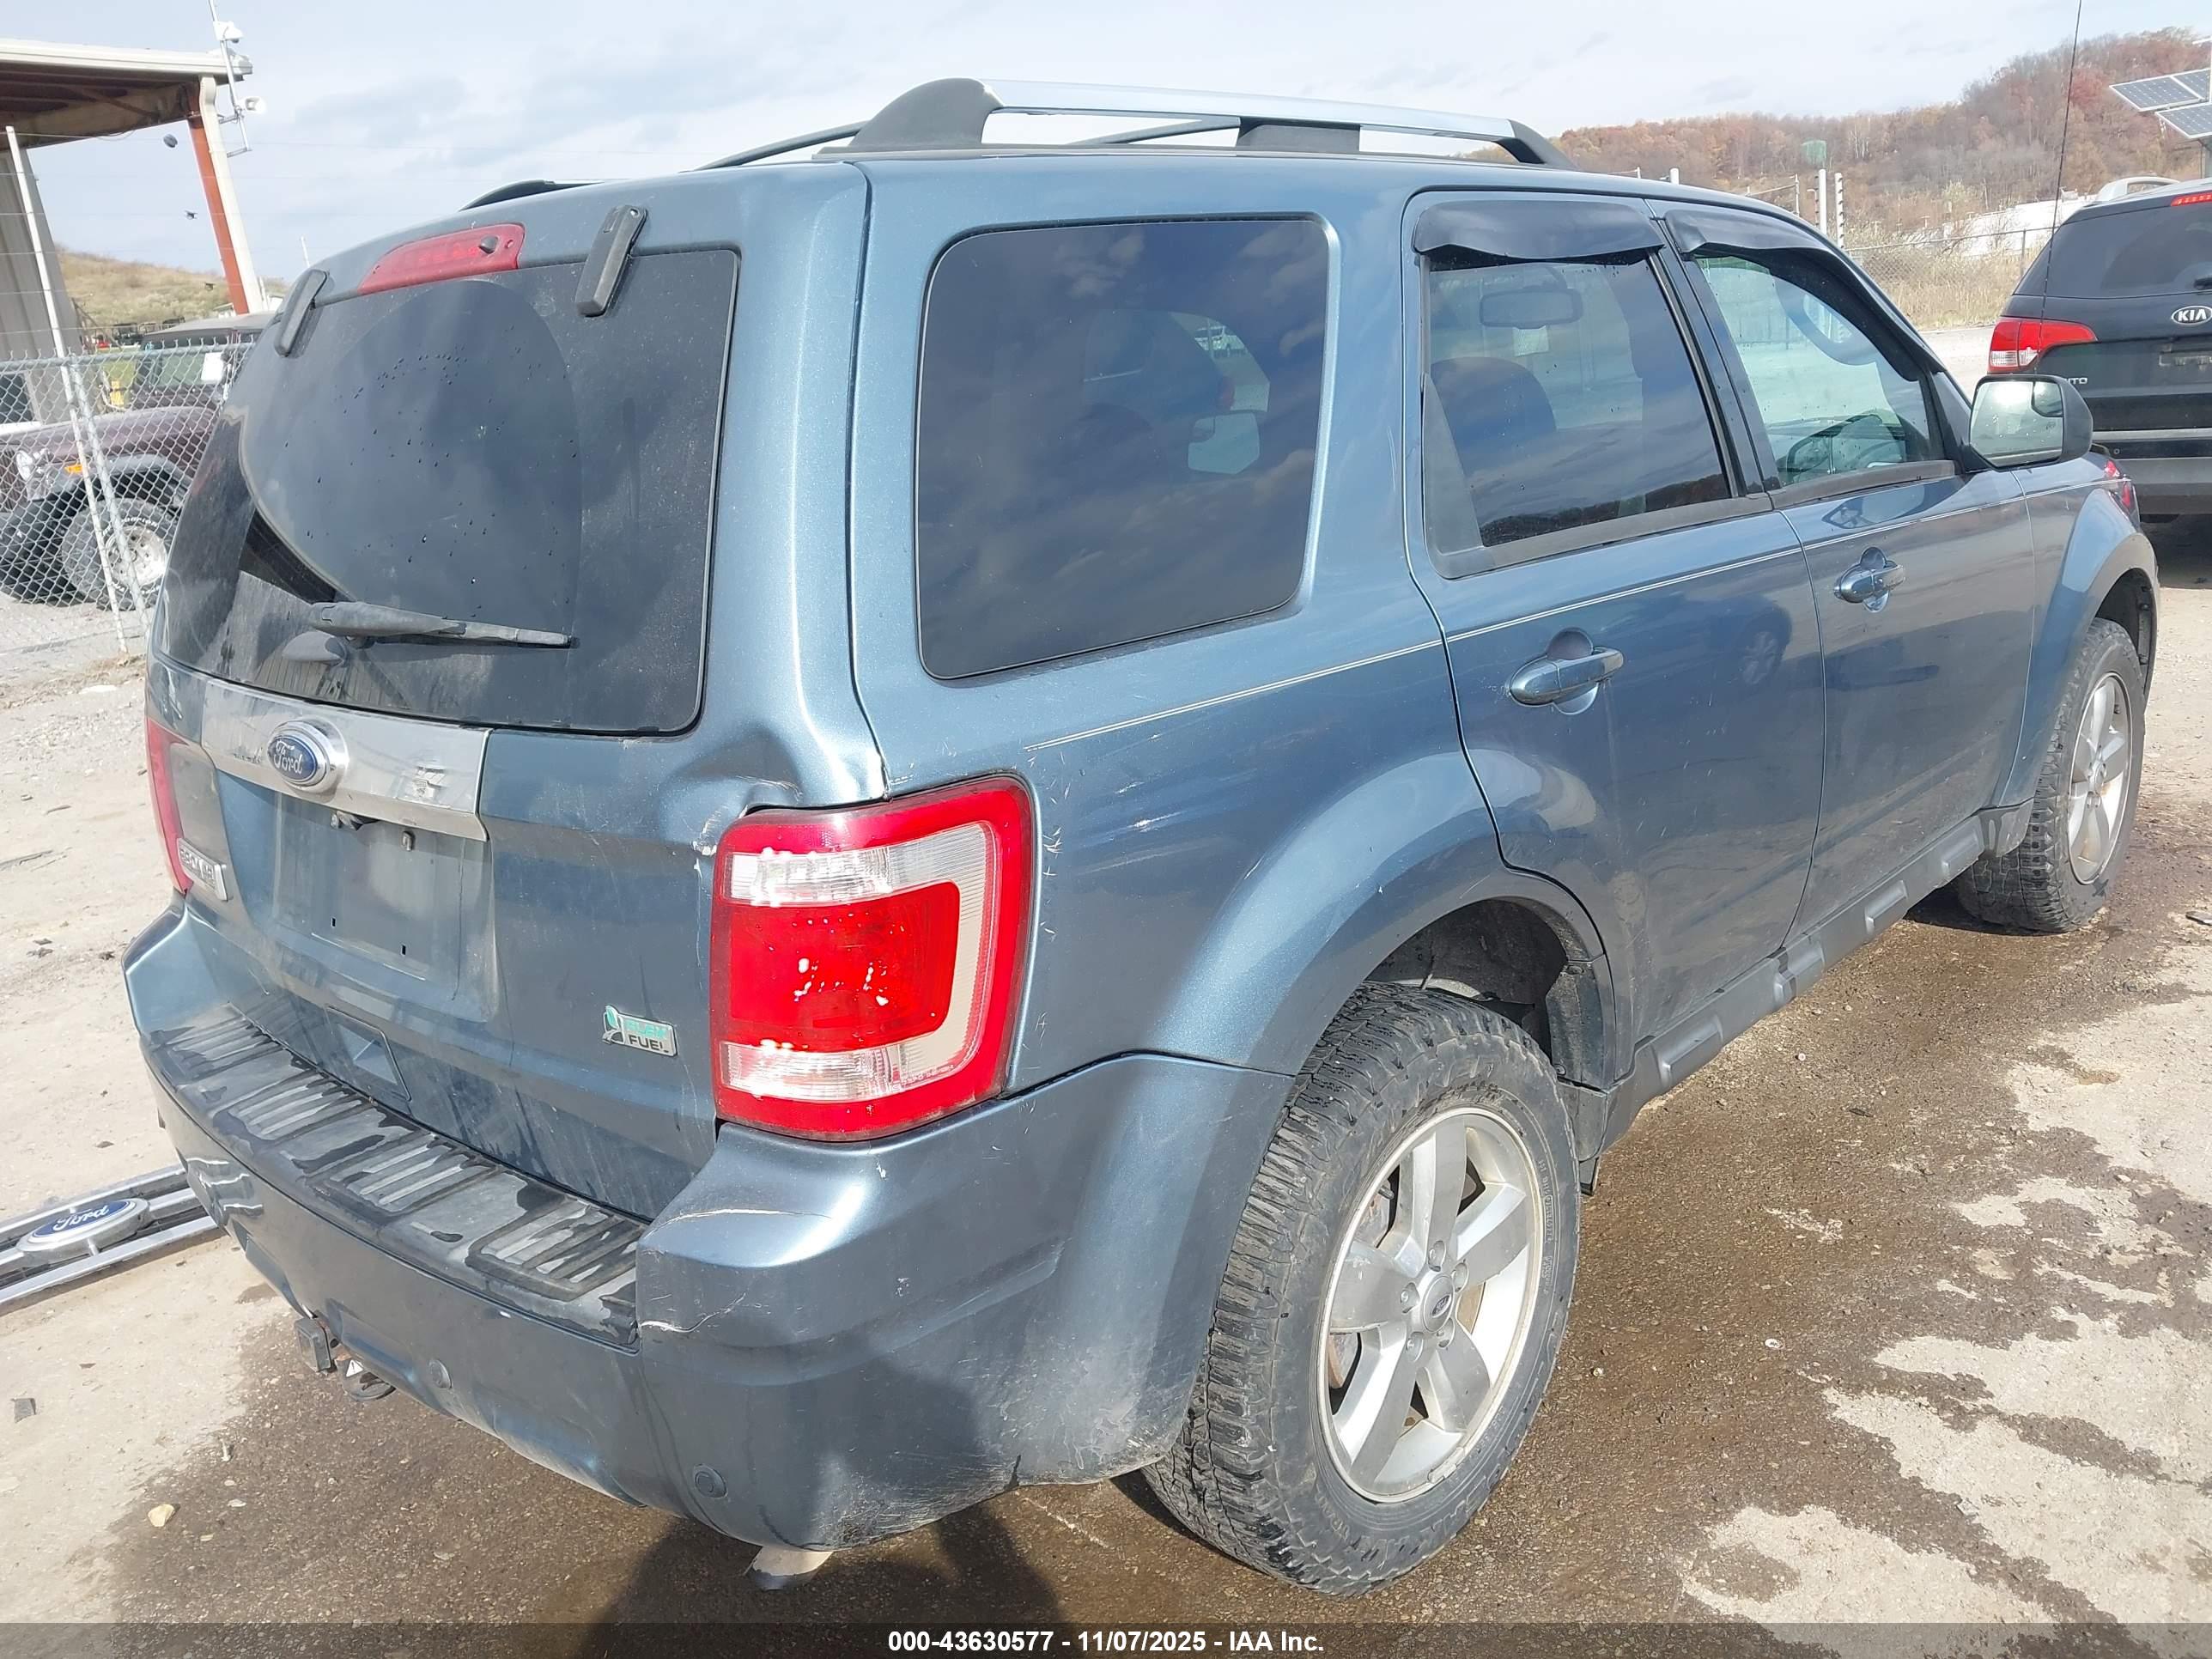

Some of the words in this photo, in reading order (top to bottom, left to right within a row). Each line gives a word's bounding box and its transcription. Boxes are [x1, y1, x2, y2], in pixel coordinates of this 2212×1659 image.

[2178, 309, 2207, 321] KIA
[274, 740, 303, 775] Ford
[628, 1034, 669, 1053] FUEL
[52, 1205, 109, 1231] Ford
